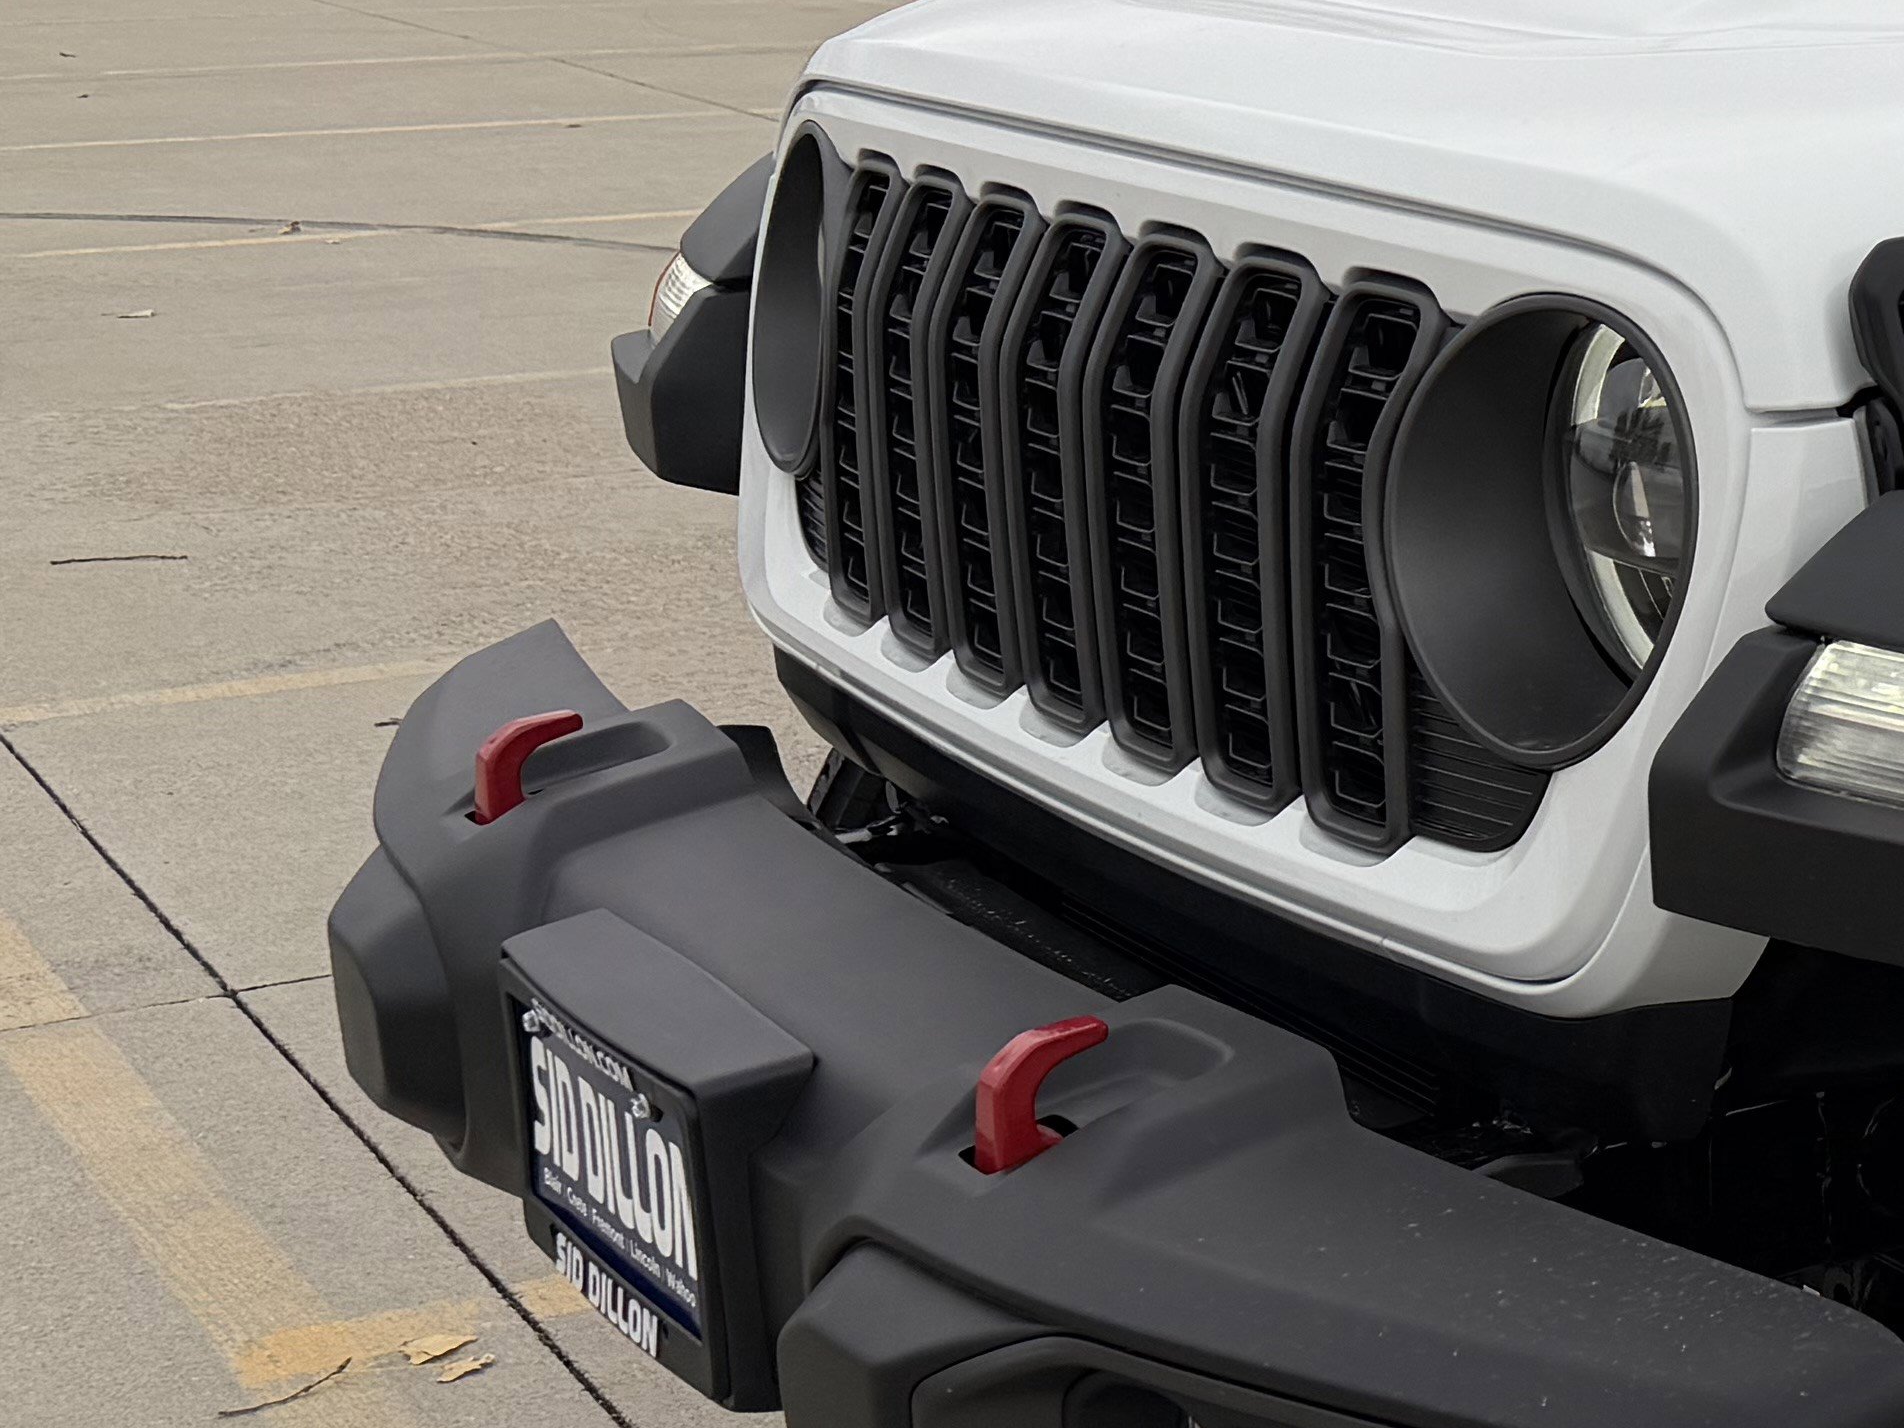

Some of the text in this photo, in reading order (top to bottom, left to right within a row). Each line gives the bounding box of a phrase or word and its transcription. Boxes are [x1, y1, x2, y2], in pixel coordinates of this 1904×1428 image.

[530, 1035, 698, 1282] SID DILLON
[555, 1231, 659, 1358] SID DILLON
